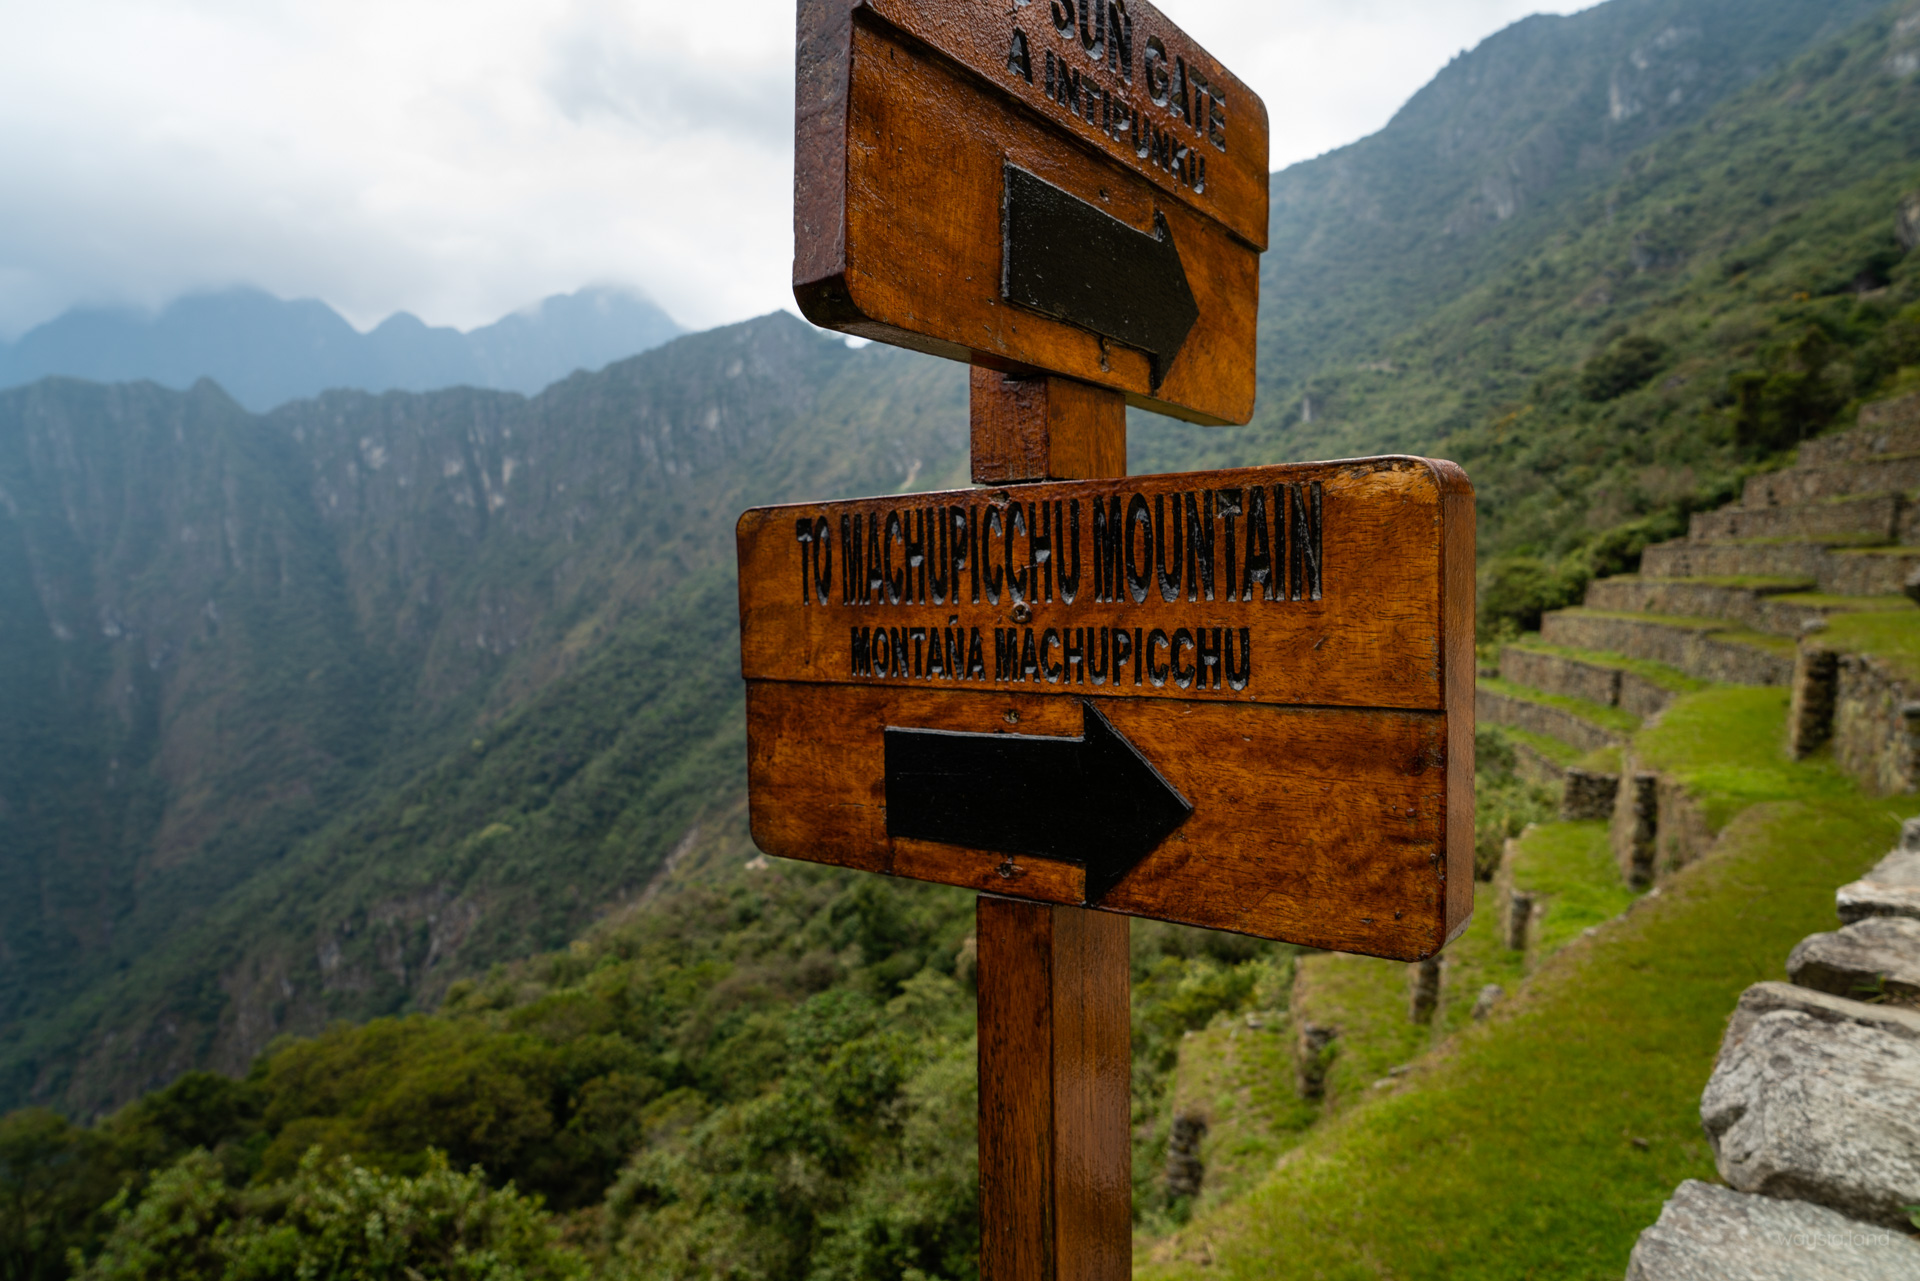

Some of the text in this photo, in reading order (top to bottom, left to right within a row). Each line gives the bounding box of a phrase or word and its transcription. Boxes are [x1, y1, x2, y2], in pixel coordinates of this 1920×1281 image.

[1007, 27, 1205, 194] A INTIPUNKU
[1145, 35, 1225, 152] GATE
[796, 481, 1322, 606] TO MACHUPICCHU MOUNTAIN
[994, 627, 1250, 691] MACHUPICCHU
